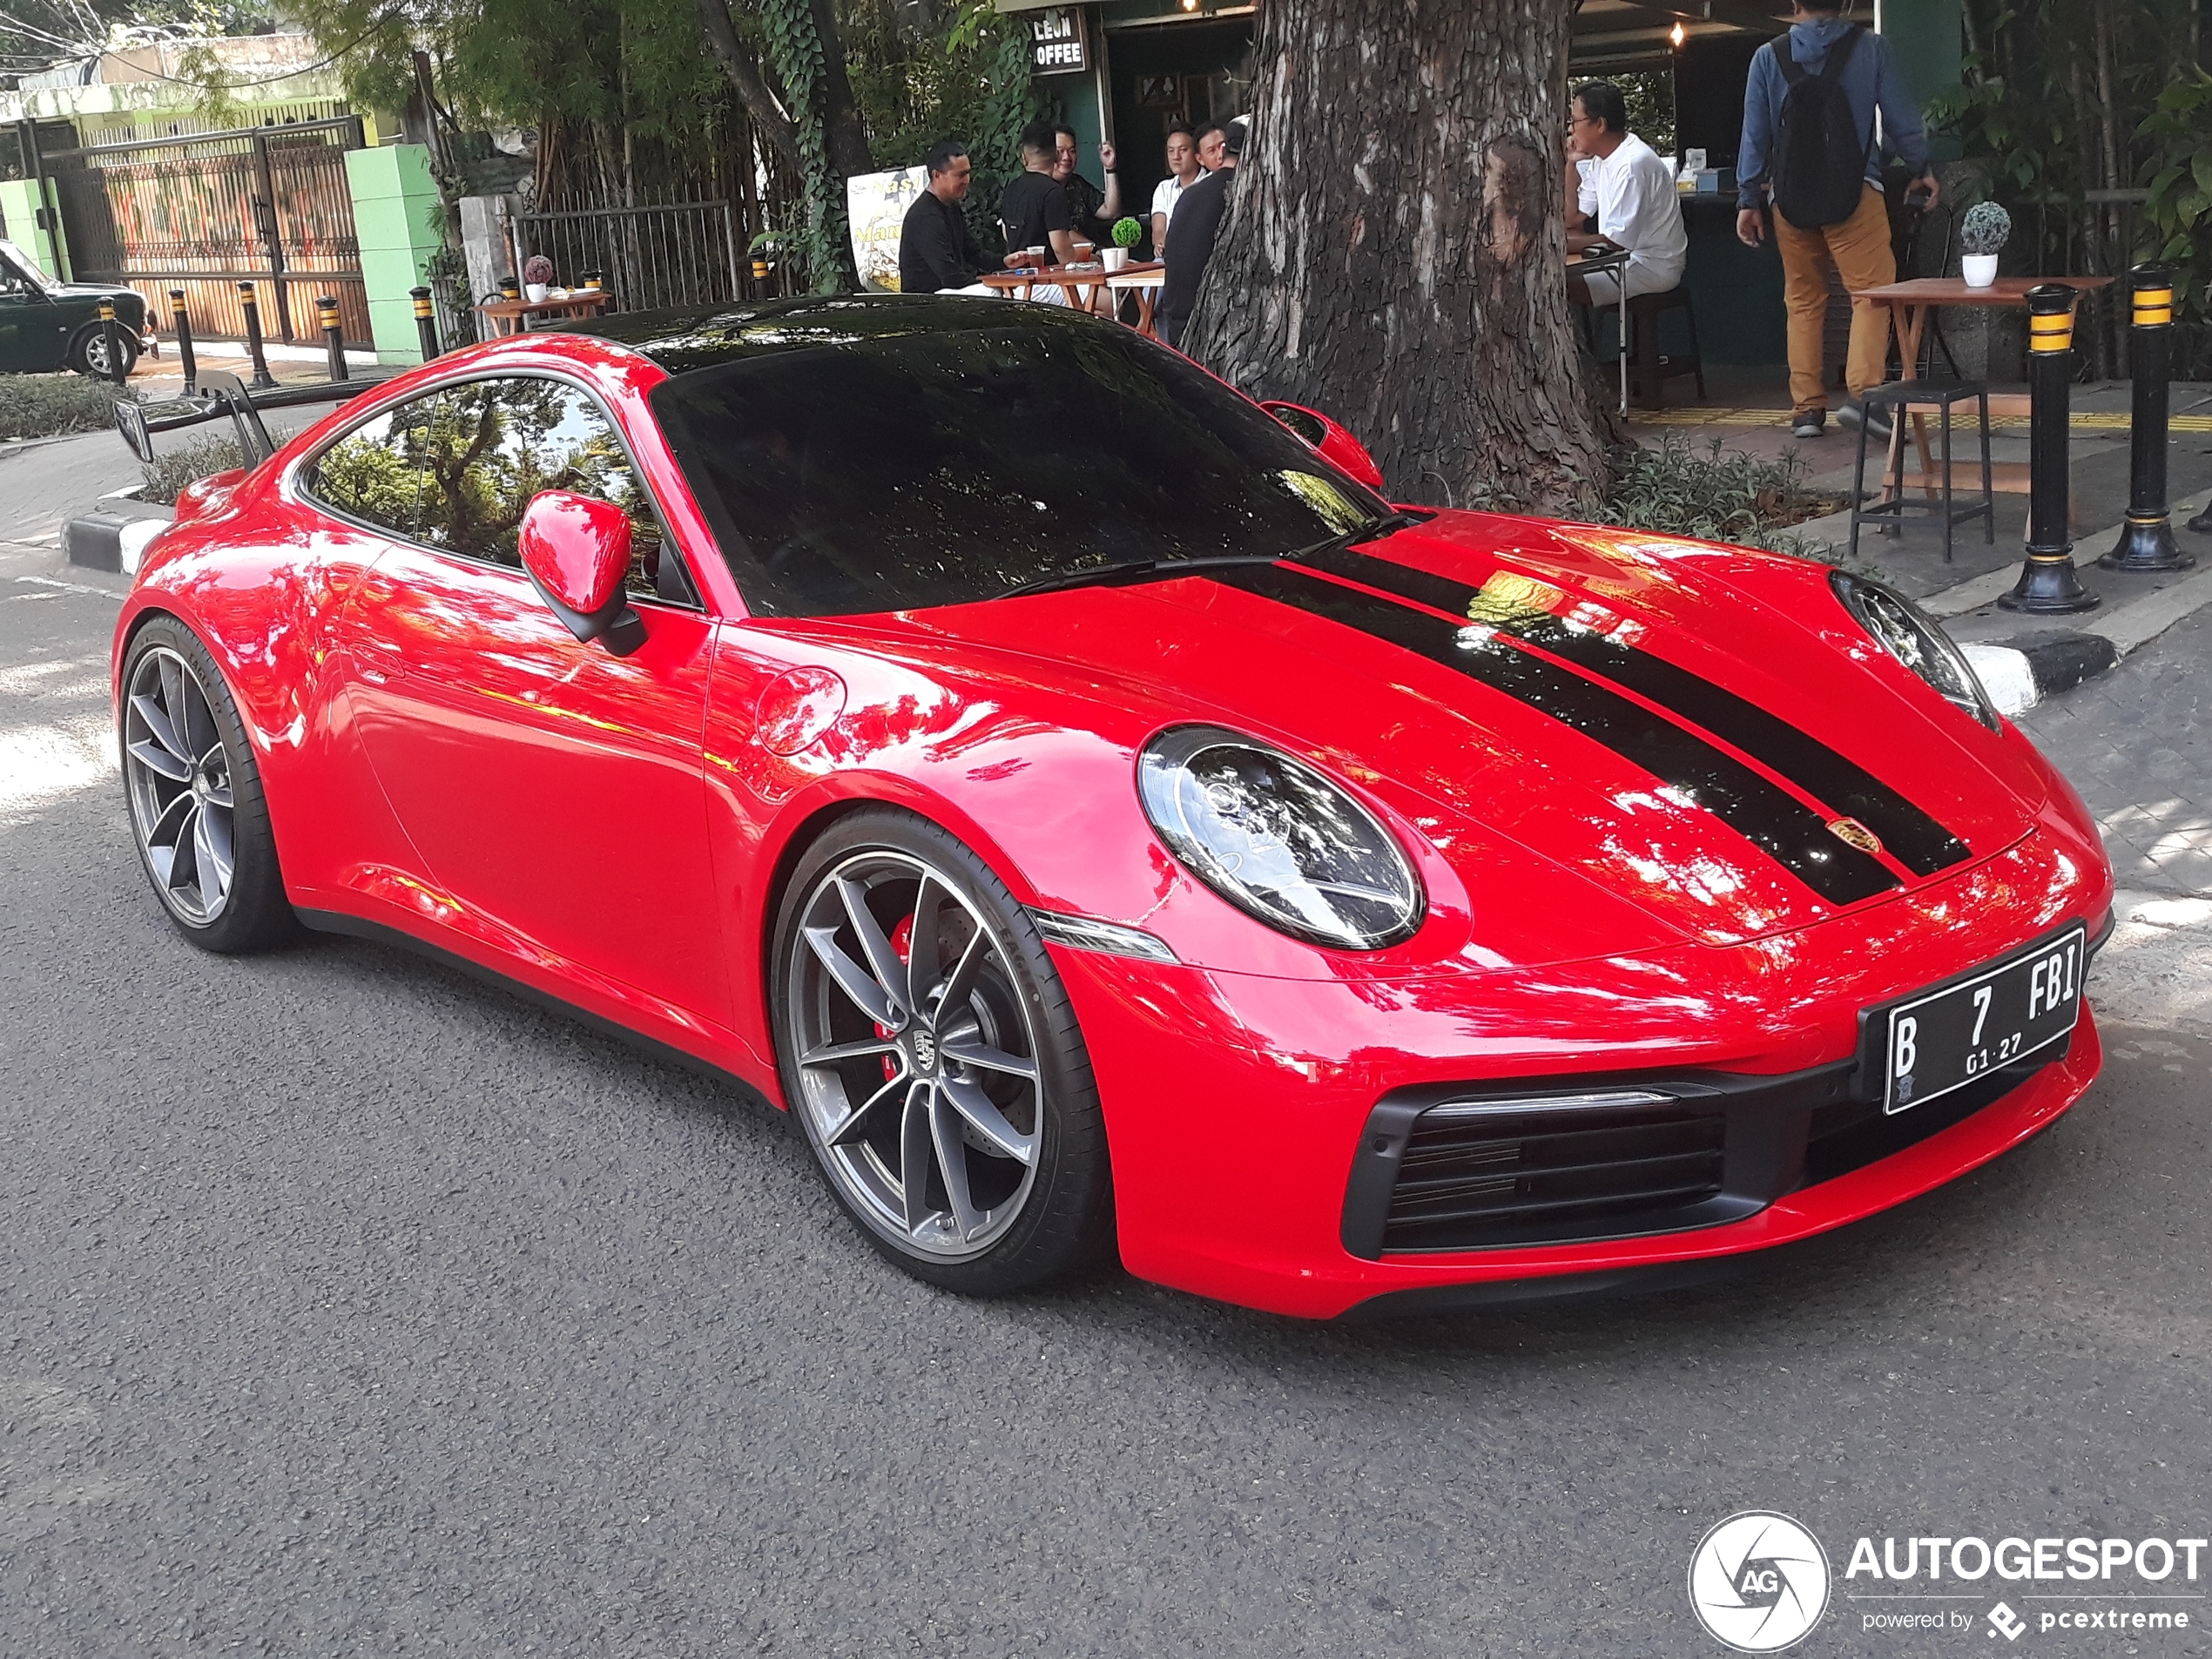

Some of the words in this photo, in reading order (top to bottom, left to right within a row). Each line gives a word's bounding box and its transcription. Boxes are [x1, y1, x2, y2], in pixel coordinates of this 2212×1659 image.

[1033, 42, 1081, 65] OFFEE
[873, 172, 920, 194] Nasi
[1896, 1016, 1918, 1078] B
[1973, 985, 1993, 1047] 7
